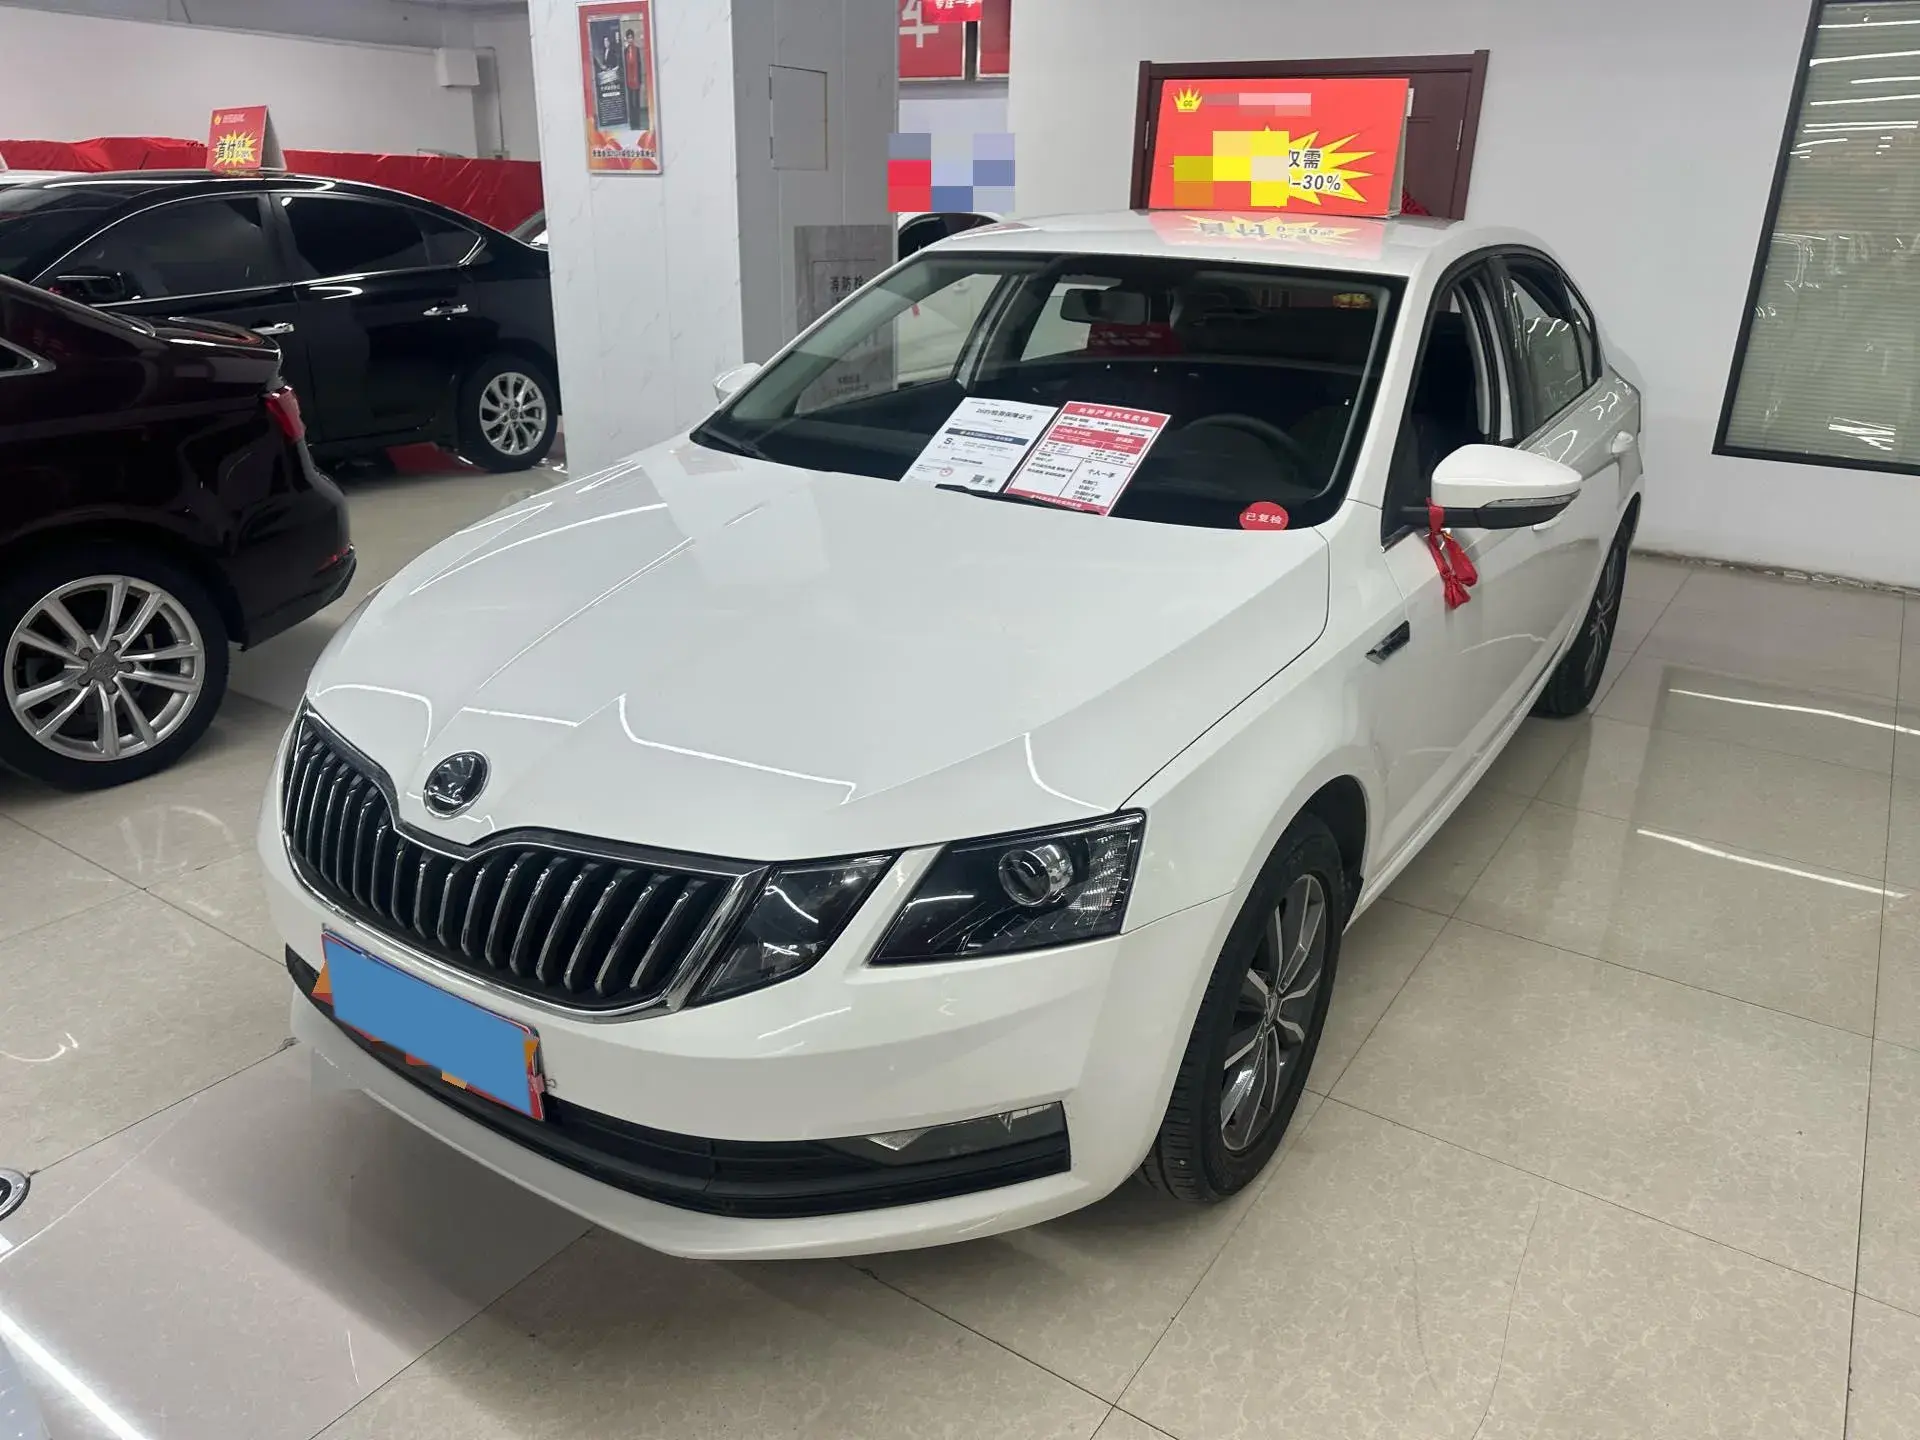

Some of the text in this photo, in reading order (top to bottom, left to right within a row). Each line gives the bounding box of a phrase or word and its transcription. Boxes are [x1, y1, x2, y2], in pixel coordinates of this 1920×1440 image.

[1288, 174, 1341, 191] -30%
[1246, 512, 1282, 525] 已复检
